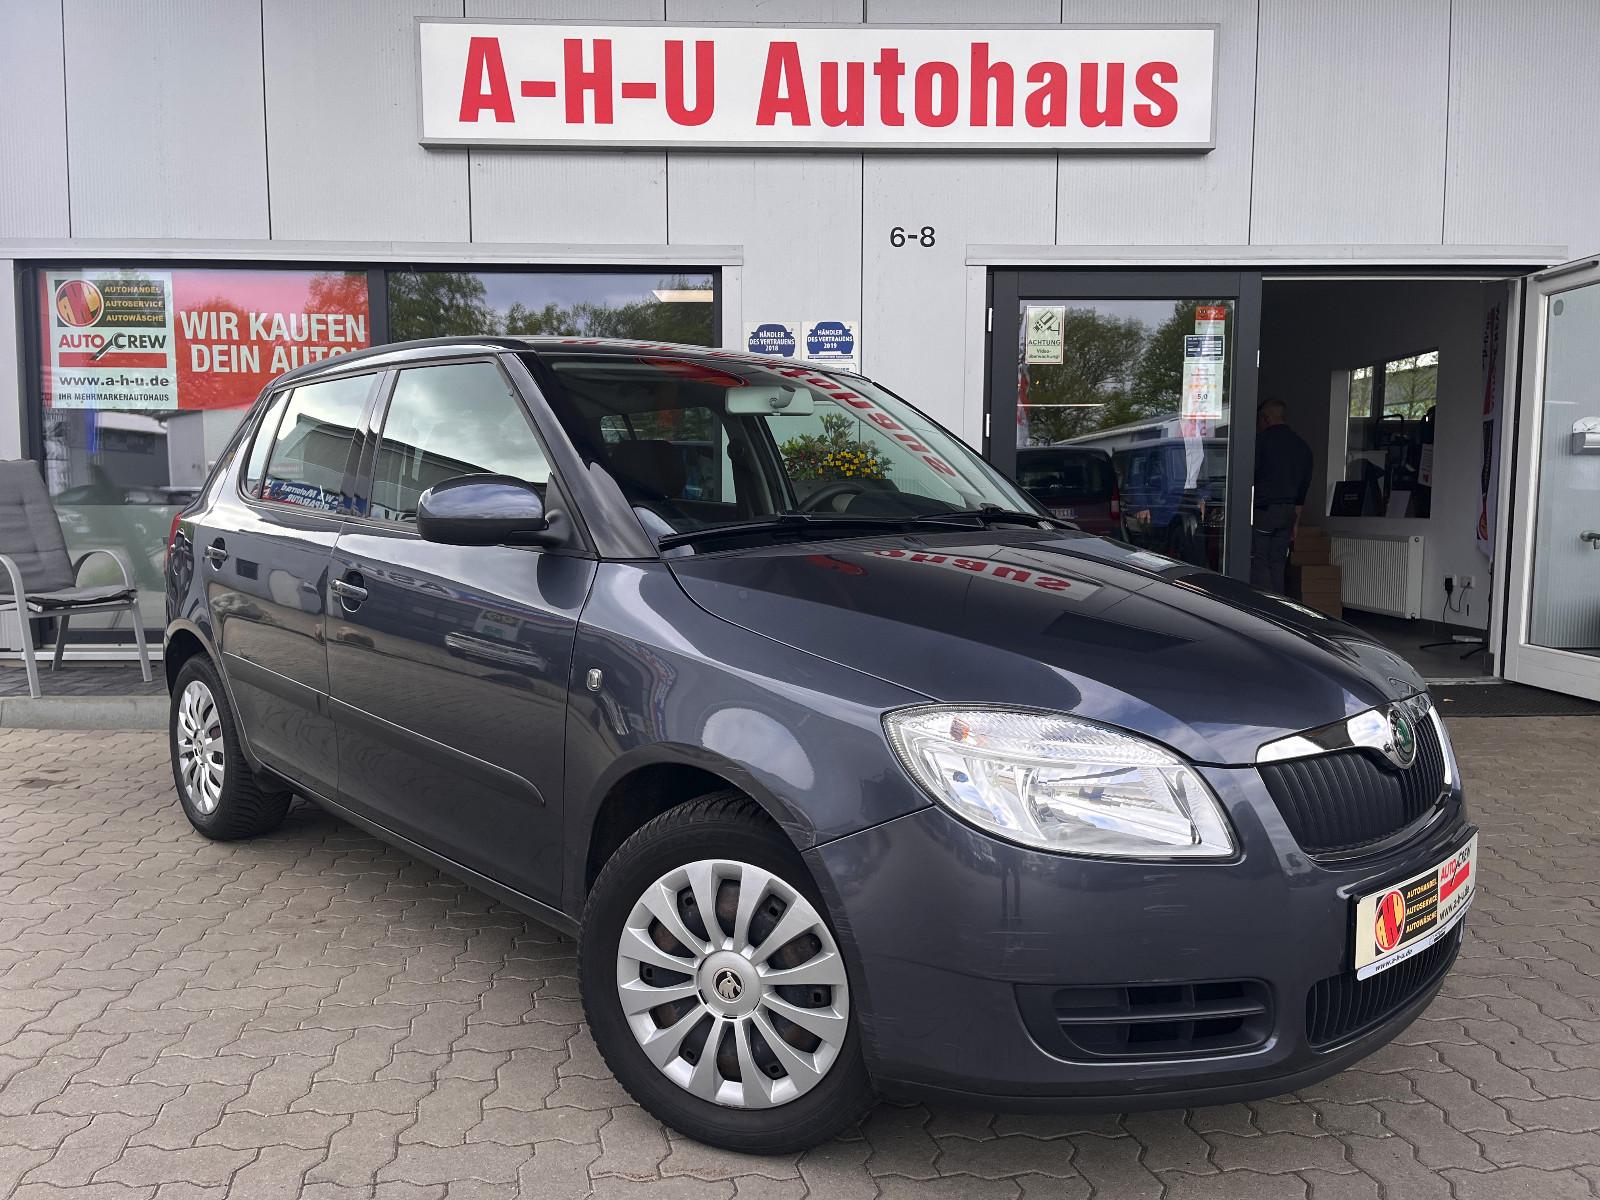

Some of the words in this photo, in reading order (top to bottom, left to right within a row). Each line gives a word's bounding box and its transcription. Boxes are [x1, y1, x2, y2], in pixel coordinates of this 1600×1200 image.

[460, 37, 714, 126] A-H-U
[757, 42, 1178, 128] Autohaus
[890, 226, 936, 248] 6-8
[104, 285, 161, 294] AUTOHANDEL
[105, 299, 164, 308] AUTOSERVICE
[106, 313, 164, 322] AUTOWÄSCHE
[180, 311, 239, 340] WIR
[249, 312, 366, 343] KAUFEN
[191, 344, 260, 374] DEIN
[270, 346, 357, 374] AUT
[59, 375, 170, 387] www.a-h-u.de
[58, 393, 72, 401] IHR
[74, 393, 169, 402] MEHRMARKENAUTOHAUS
[1407, 878, 1438, 899] AUTOHANDEL
[1406, 893, 1438, 915] AUTOSERVICE
[1406, 910, 1437, 933] AUTOWÄSCHE
